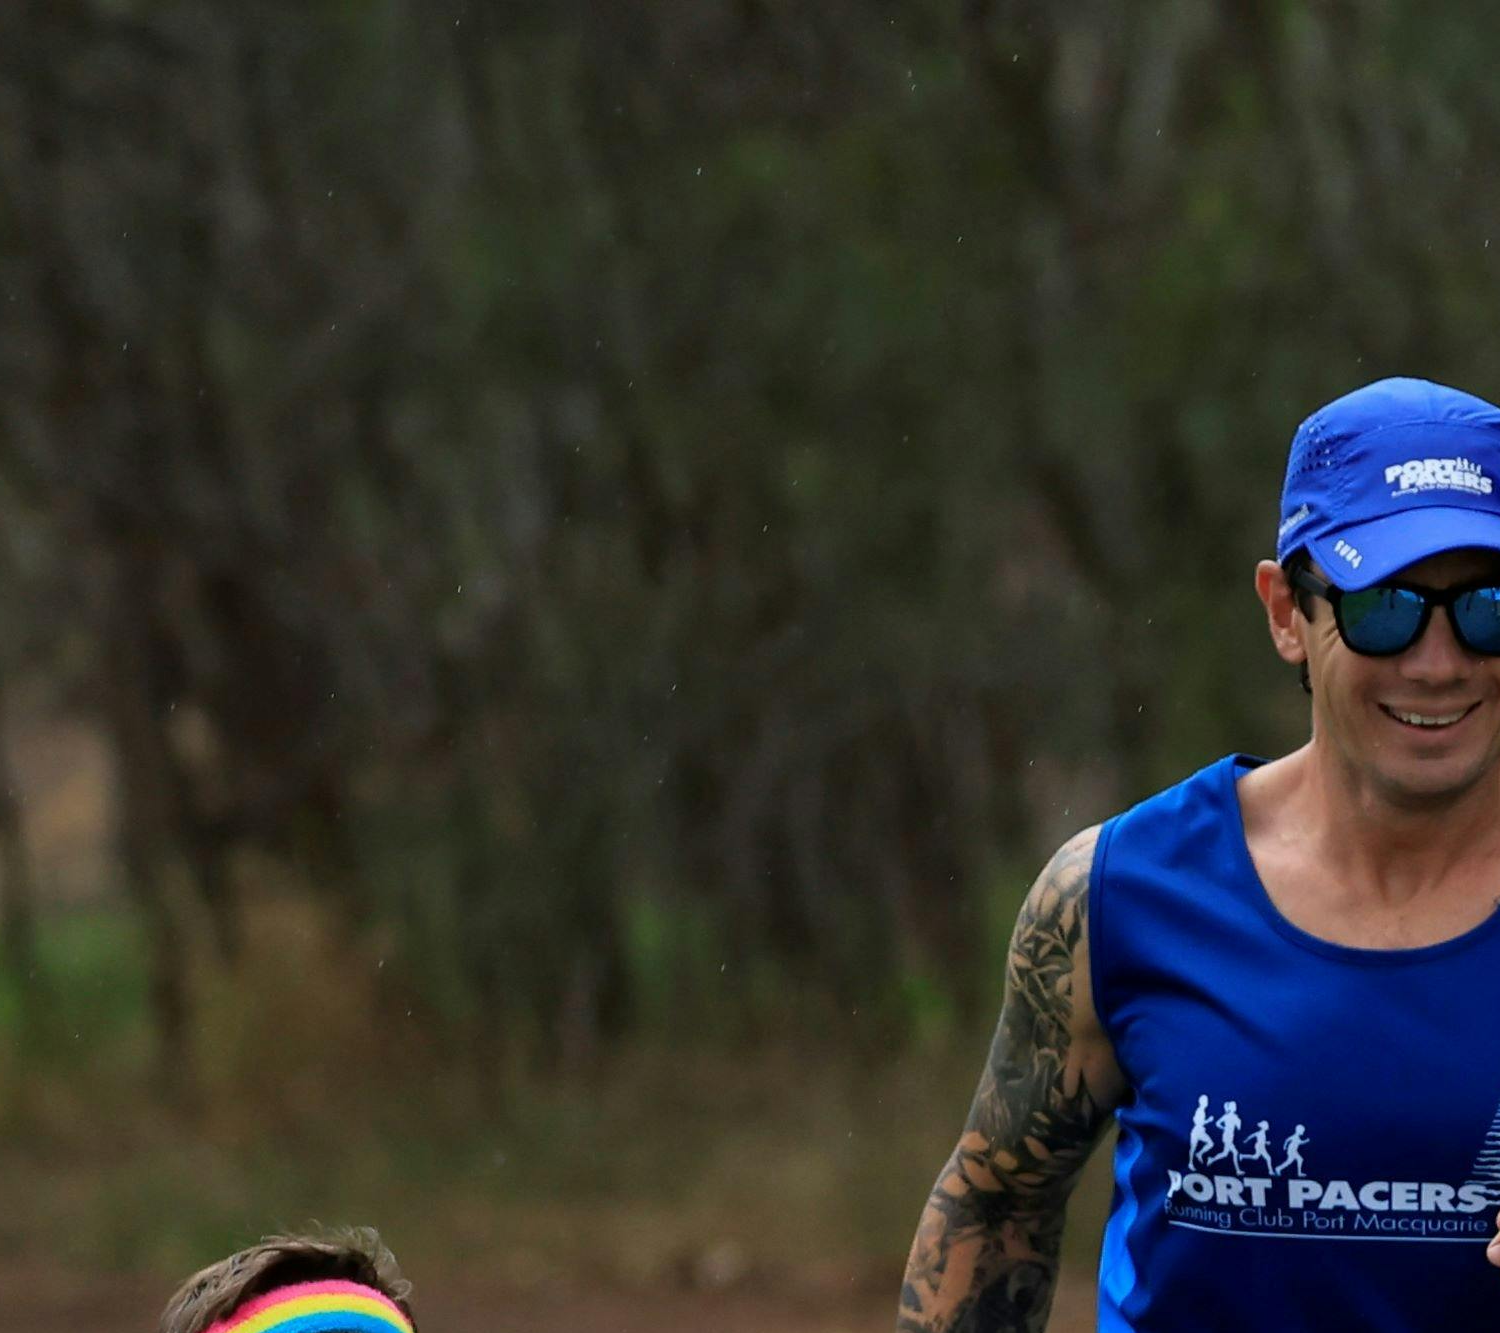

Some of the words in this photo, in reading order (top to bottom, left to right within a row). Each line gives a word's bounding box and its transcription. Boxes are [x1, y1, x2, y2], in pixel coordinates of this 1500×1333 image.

[1384, 458, 1457, 485] PORT
[1398, 470, 1493, 495] PACERS
[1167, 1169, 1272, 1209] PORT
[1288, 1179, 1488, 1213] PACERS
[1164, 1200, 1231, 1229] Running
[1239, 1207, 1294, 1229] Club
[1303, 1211, 1345, 1230] Port
[1354, 1213, 1488, 1235] Macquarie
